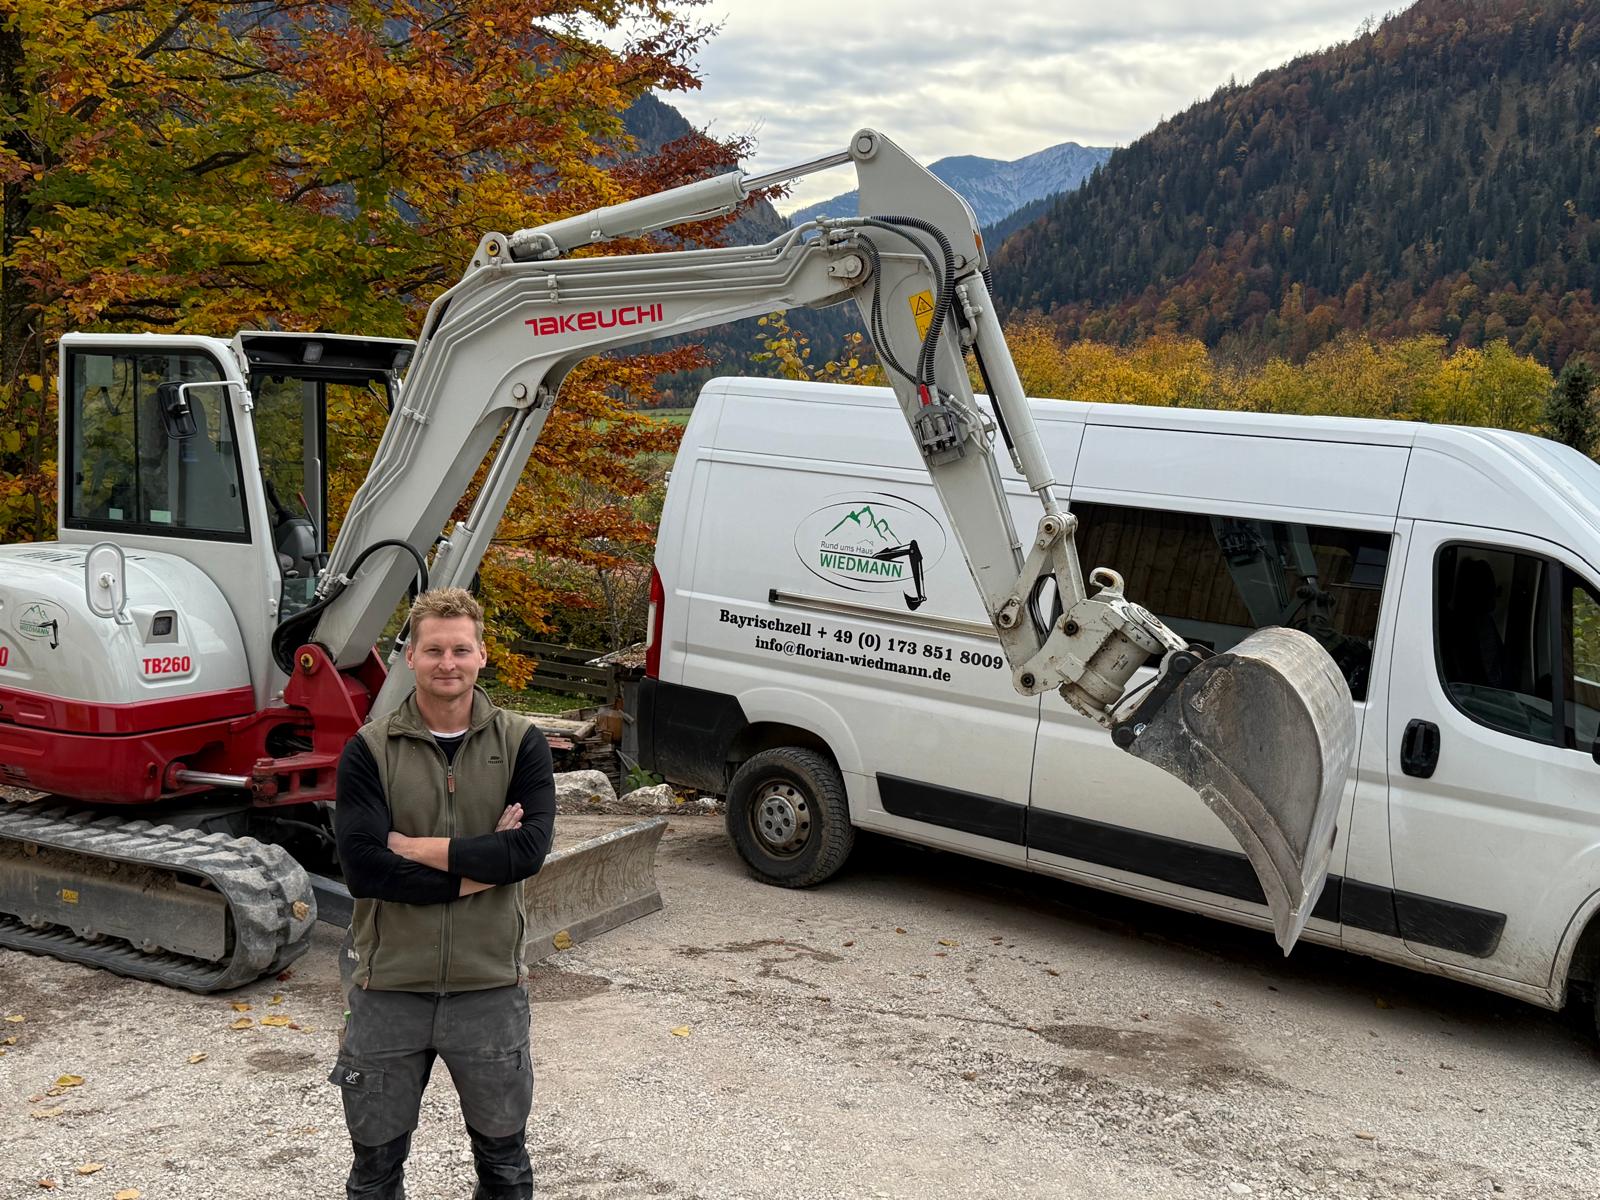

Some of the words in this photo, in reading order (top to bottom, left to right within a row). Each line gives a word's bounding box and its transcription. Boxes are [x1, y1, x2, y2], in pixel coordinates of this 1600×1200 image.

[820, 541, 839, 550] Rund
[856, 546, 874, 555] Haus
[820, 553, 903, 578] WIEDMANN
[719, 609, 811, 636] Bayrischzell
[817, 627, 827, 638] +
[833, 629, 853, 644] 49
[858, 632, 881, 651] (0)
[887, 638, 917, 655] 173
[922, 644, 953, 661] 851
[960, 650, 1003, 670] 8009
[143, 656, 191, 675] TB260
[755, 635, 951, 682] info@florian-wiedmann.de
